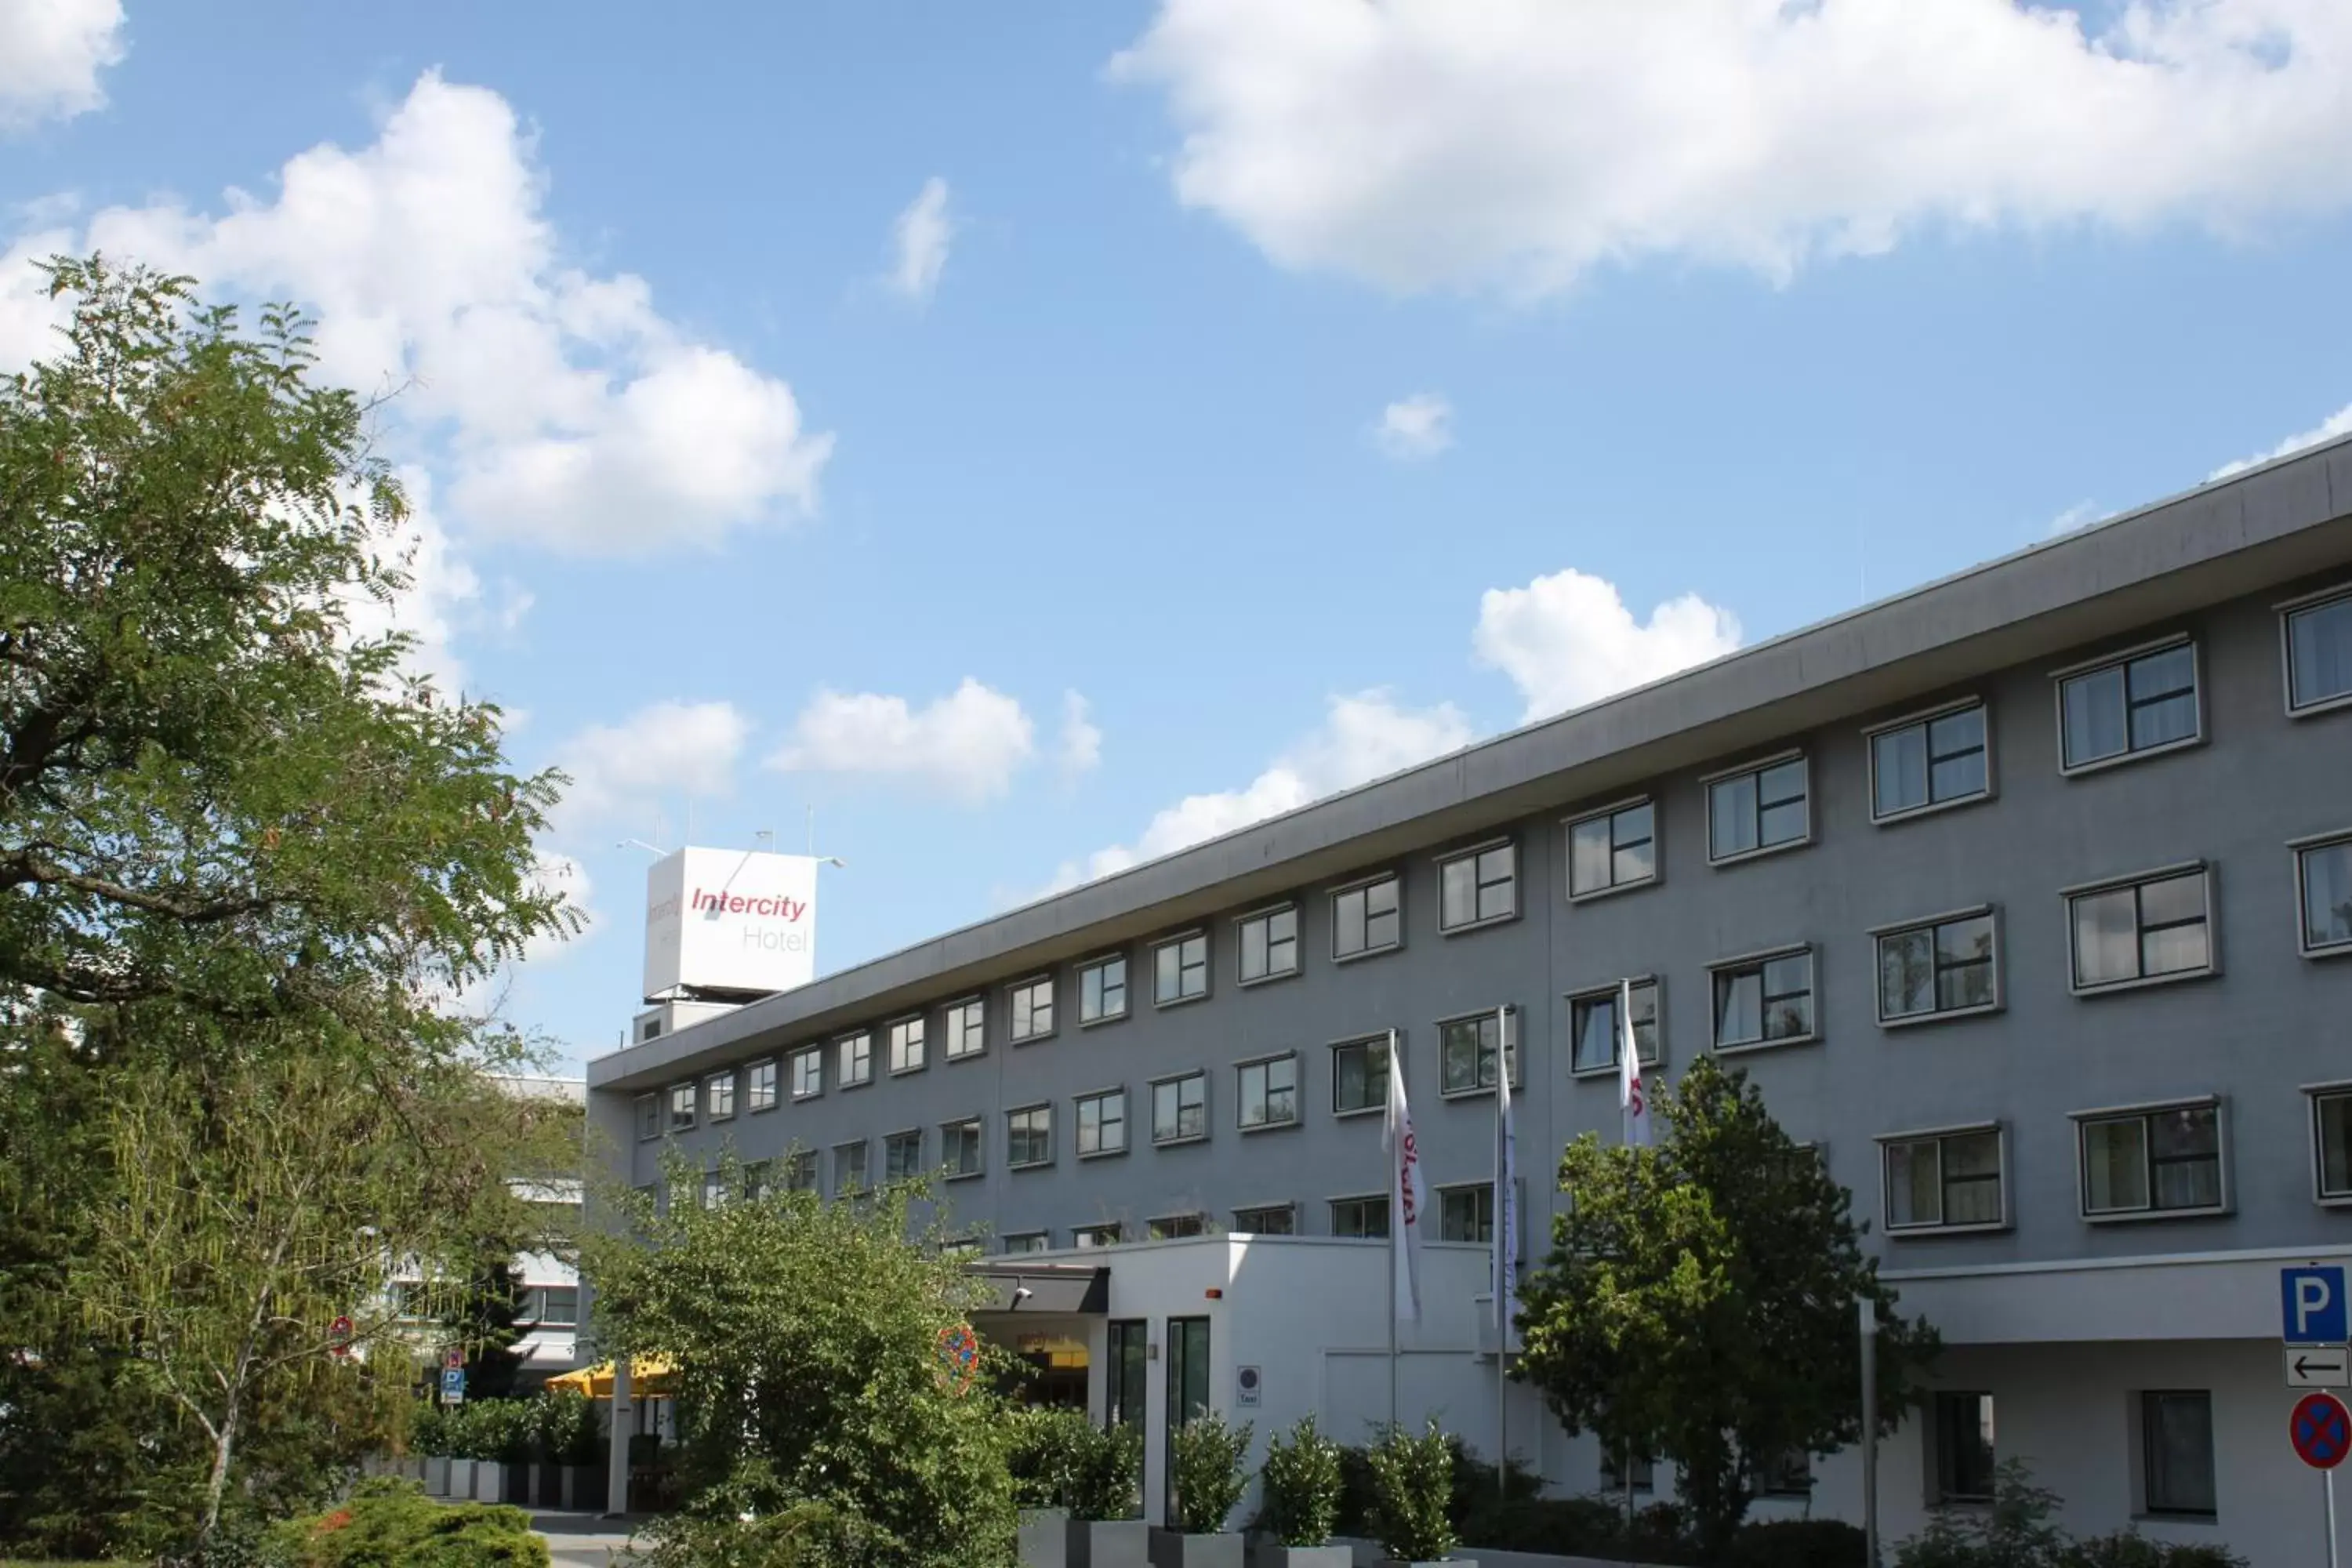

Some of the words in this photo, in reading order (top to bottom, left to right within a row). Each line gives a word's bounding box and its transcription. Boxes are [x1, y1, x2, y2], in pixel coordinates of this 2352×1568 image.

[691, 887, 806, 923] Intercity
[743, 924, 807, 953] Hotel
[2295, 1276, 2330, 1334] P
